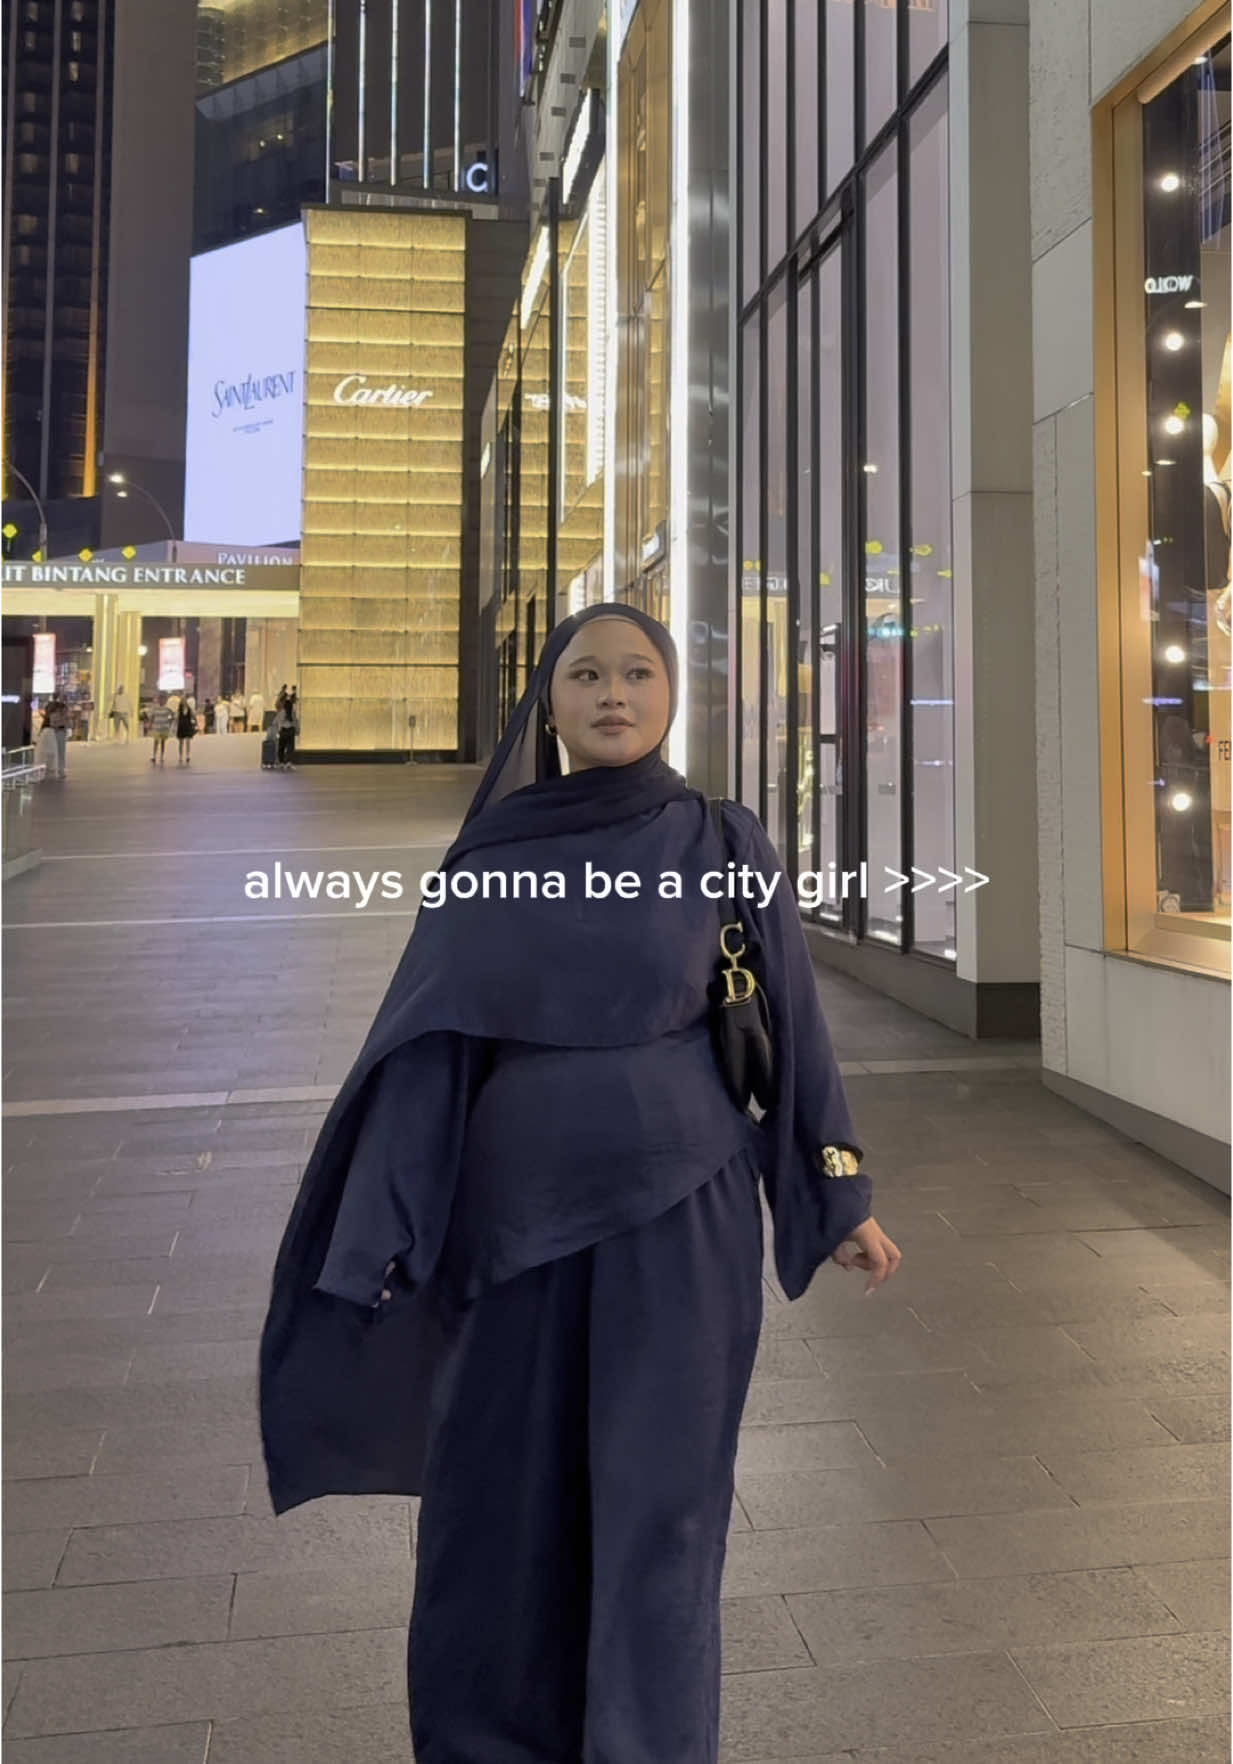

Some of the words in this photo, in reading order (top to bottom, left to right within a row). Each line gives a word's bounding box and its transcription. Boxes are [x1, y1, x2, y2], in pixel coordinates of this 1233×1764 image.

[333, 375, 433, 405] Cartier
[2, 565, 27, 582] IT
[31, 565, 127, 583] BINTANG
[133, 566, 246, 585] ENTRANCE
